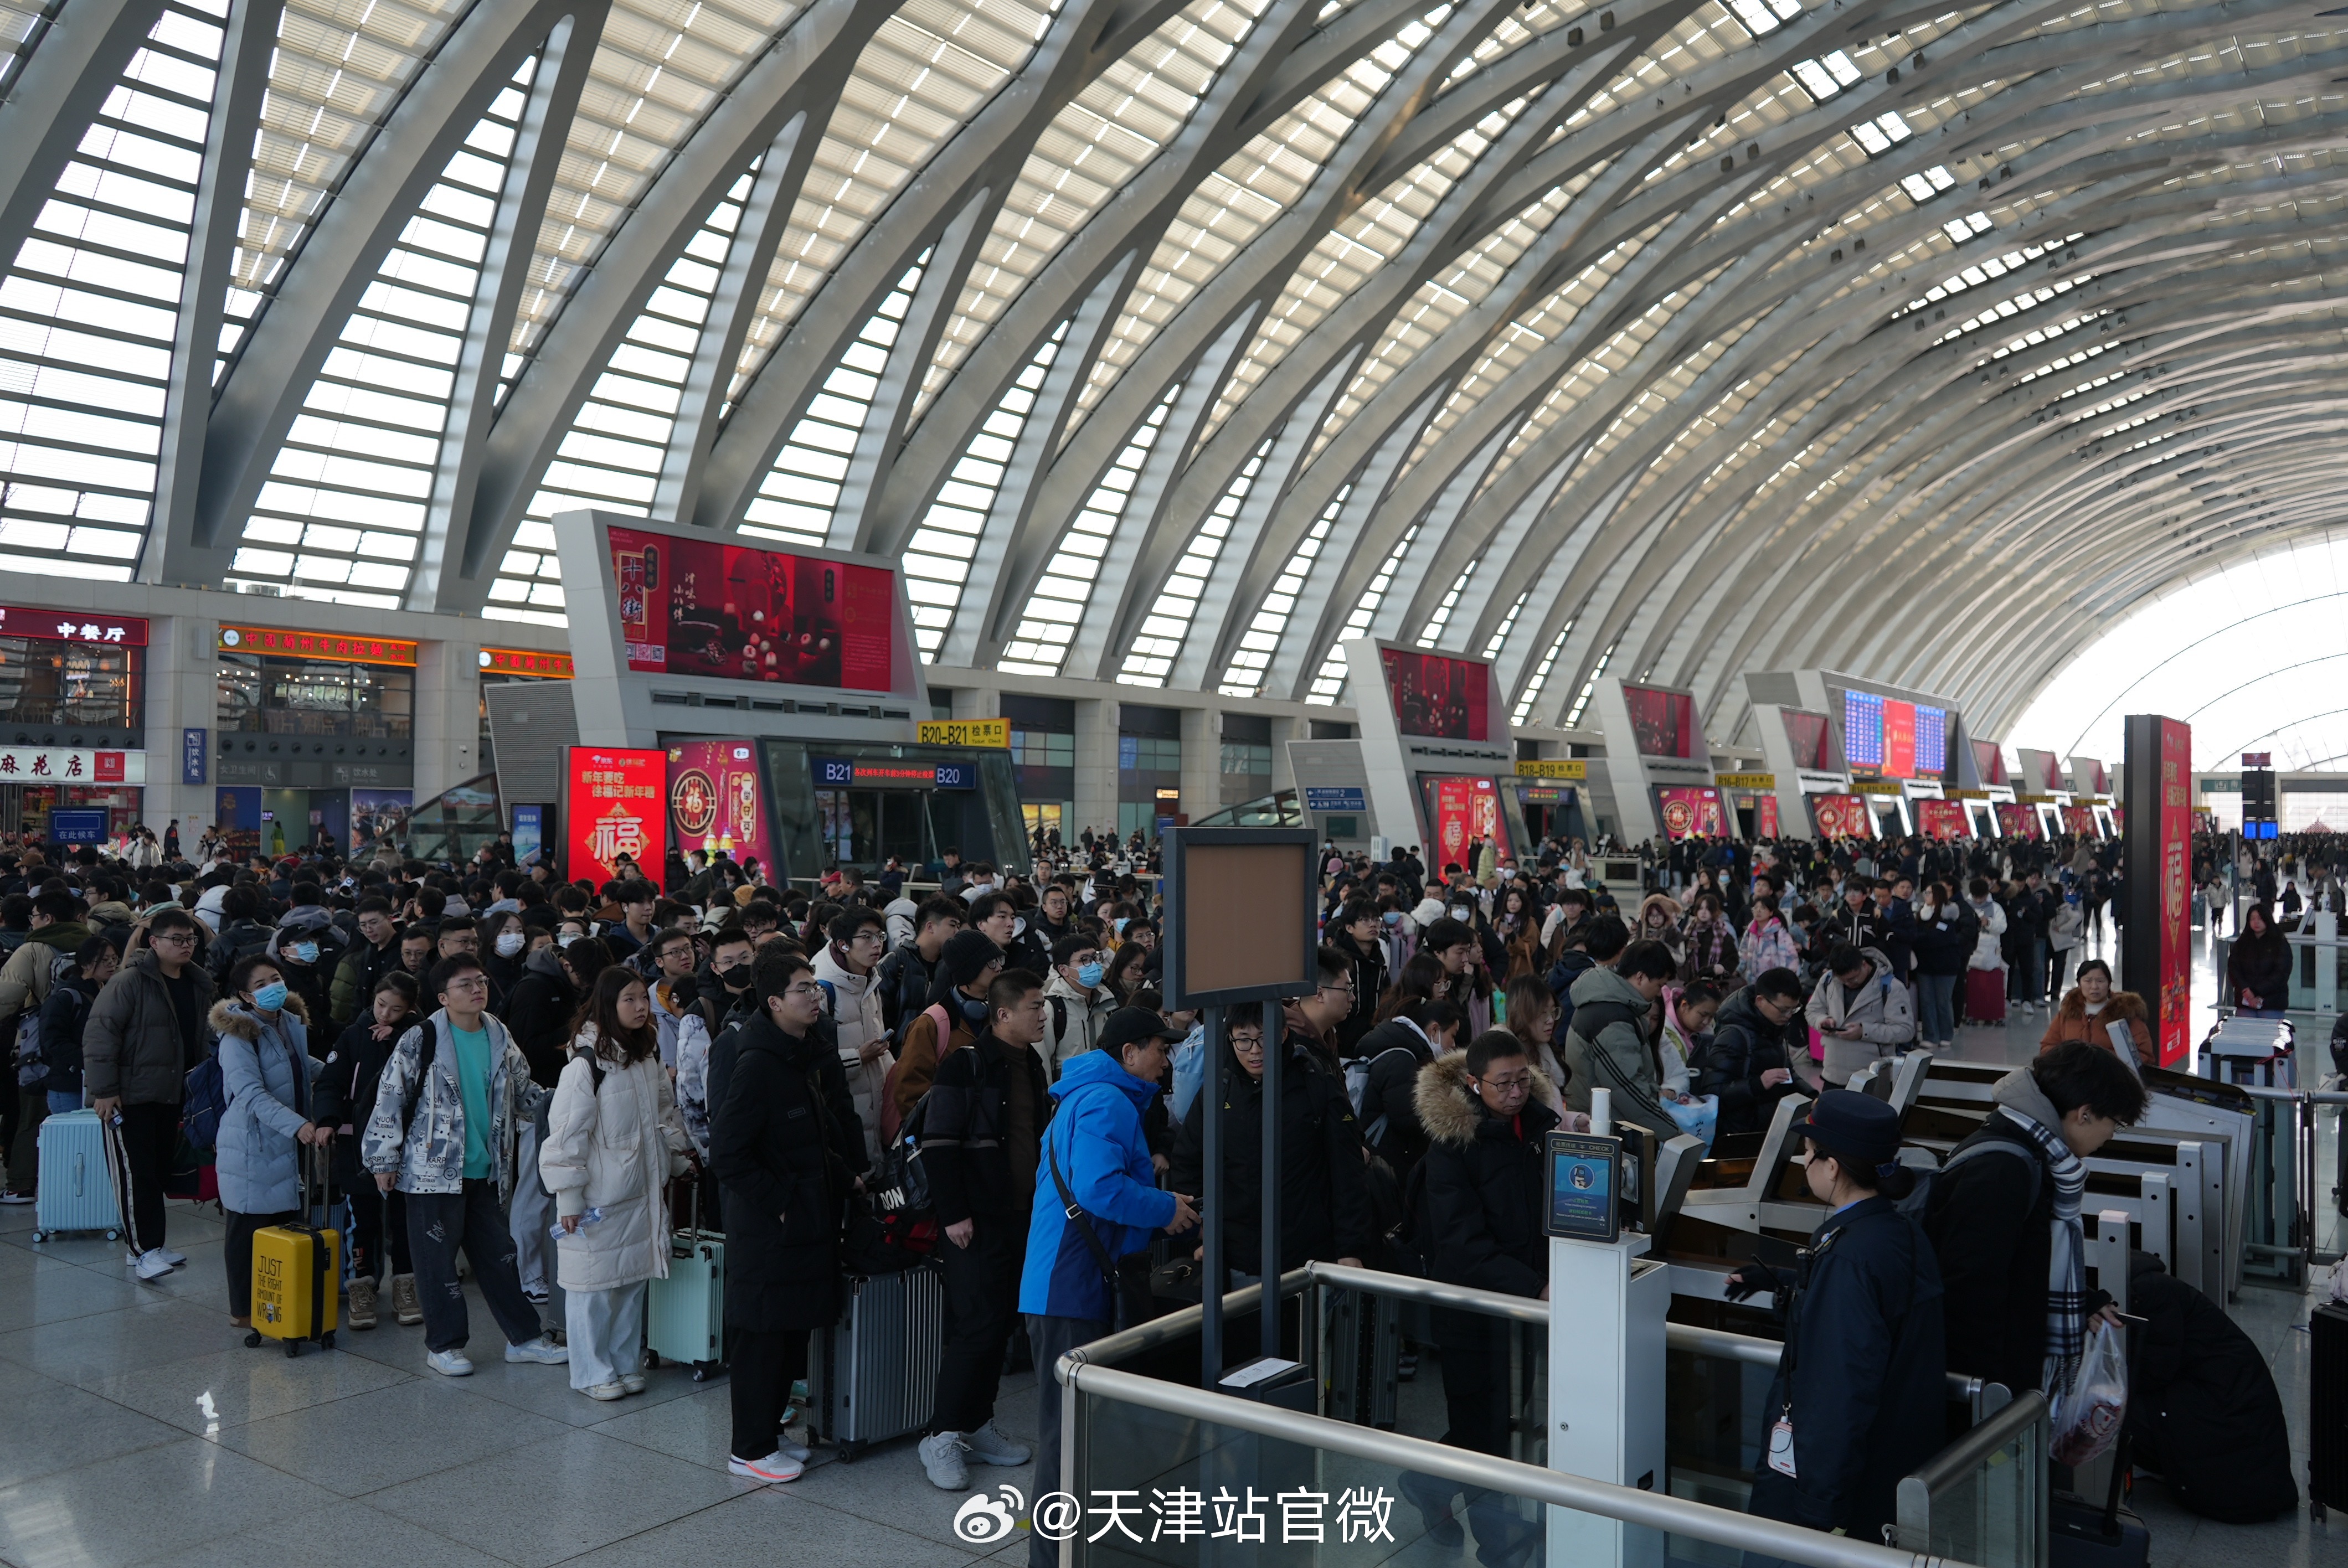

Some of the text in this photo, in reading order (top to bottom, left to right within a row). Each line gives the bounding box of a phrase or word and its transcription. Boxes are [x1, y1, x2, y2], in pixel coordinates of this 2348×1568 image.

[56, 622, 126, 642] 中餐厅
[922, 725, 1002, 745] B20-B21 检票口
[0, 754, 83, 777] 麻花店
[190, 748, 200, 777] 饮水处
[220, 765, 256, 775] 女卫生间
[1519, 764, 1555, 777] B18-B19
[353, 767, 378, 778] 饮水处
[581, 771, 625, 785] 新年要吃
[826, 763, 851, 781] B21
[936, 768, 960, 784] B20
[593, 785, 655, 799] 徐福记新年糖
[59, 831, 96, 839] 在此候车
[593, 816, 643, 863] 福
[1445, 821, 1462, 847] 福
[2167, 841, 2184, 921] 福
[376, 1116, 395, 1124] HUOH
[258, 1255, 283, 1278] JUST
[257, 1274, 282, 1291] THE RIGHT
[256, 1288, 282, 1304] AMOUNT OF
